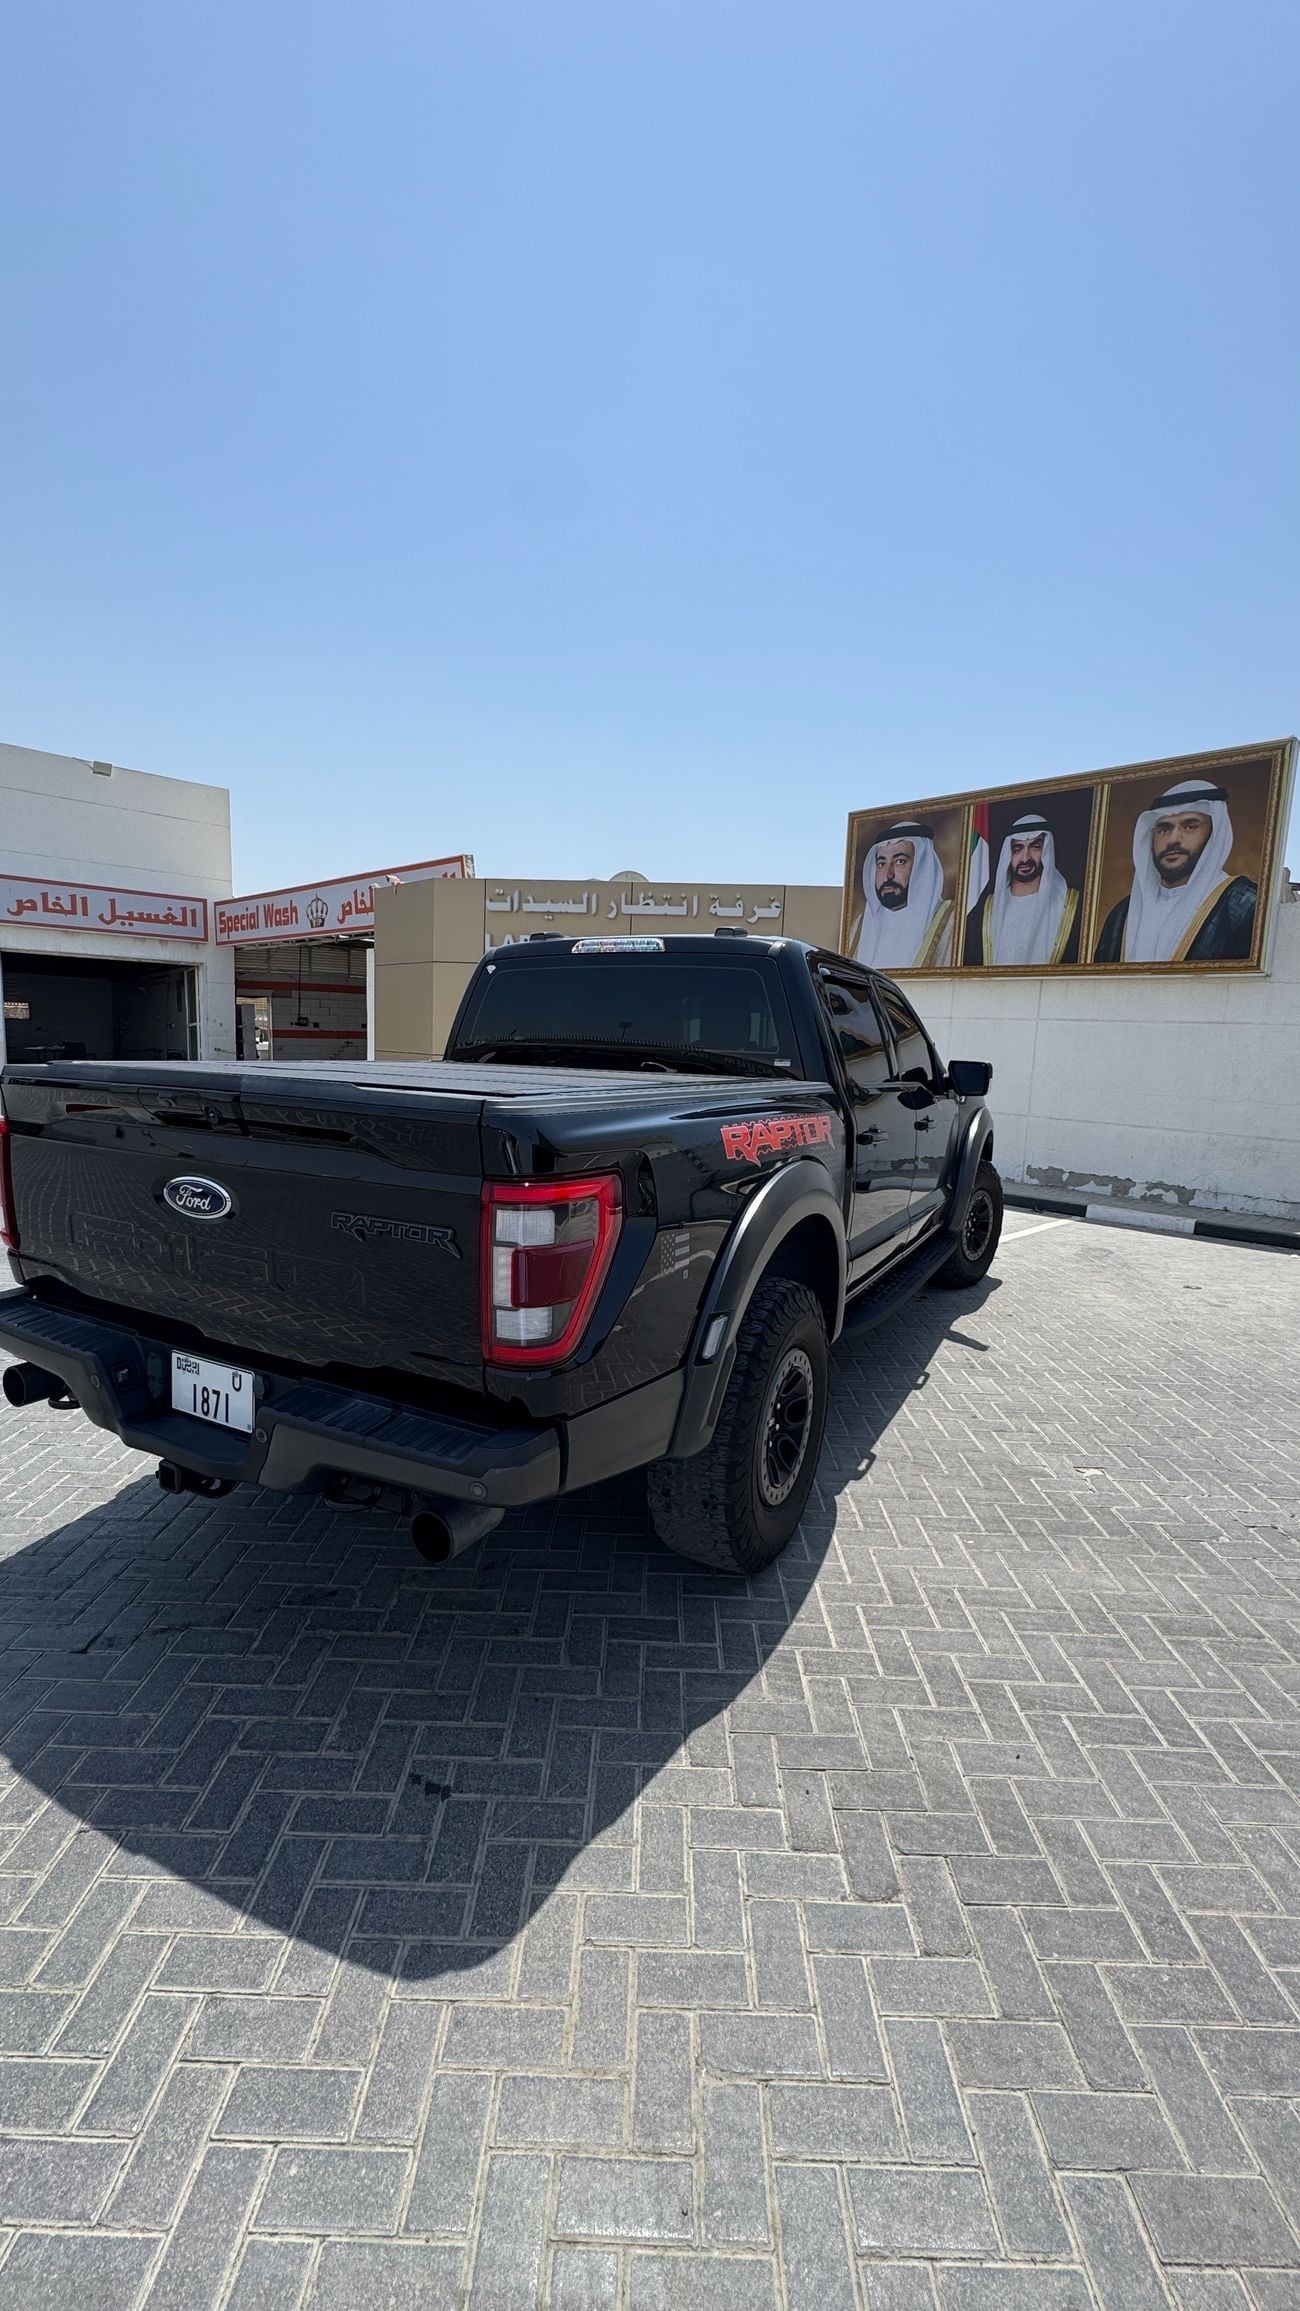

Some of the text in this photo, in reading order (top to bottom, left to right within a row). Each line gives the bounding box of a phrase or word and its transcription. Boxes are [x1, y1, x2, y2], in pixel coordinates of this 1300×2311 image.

[7, 892, 197, 928] الغسيل الخاص
[218, 899, 299, 935] Special Wash
[337, 885, 375, 924] لخاص
[485, 887, 783, 924] غرفة انتظار السيدات
[720, 1116, 835, 1167] RAPTOR
[175, 1184, 212, 1212] Ford
[331, 1212, 463, 1259] RAPTOR
[192, 1383, 230, 1424] 1871
